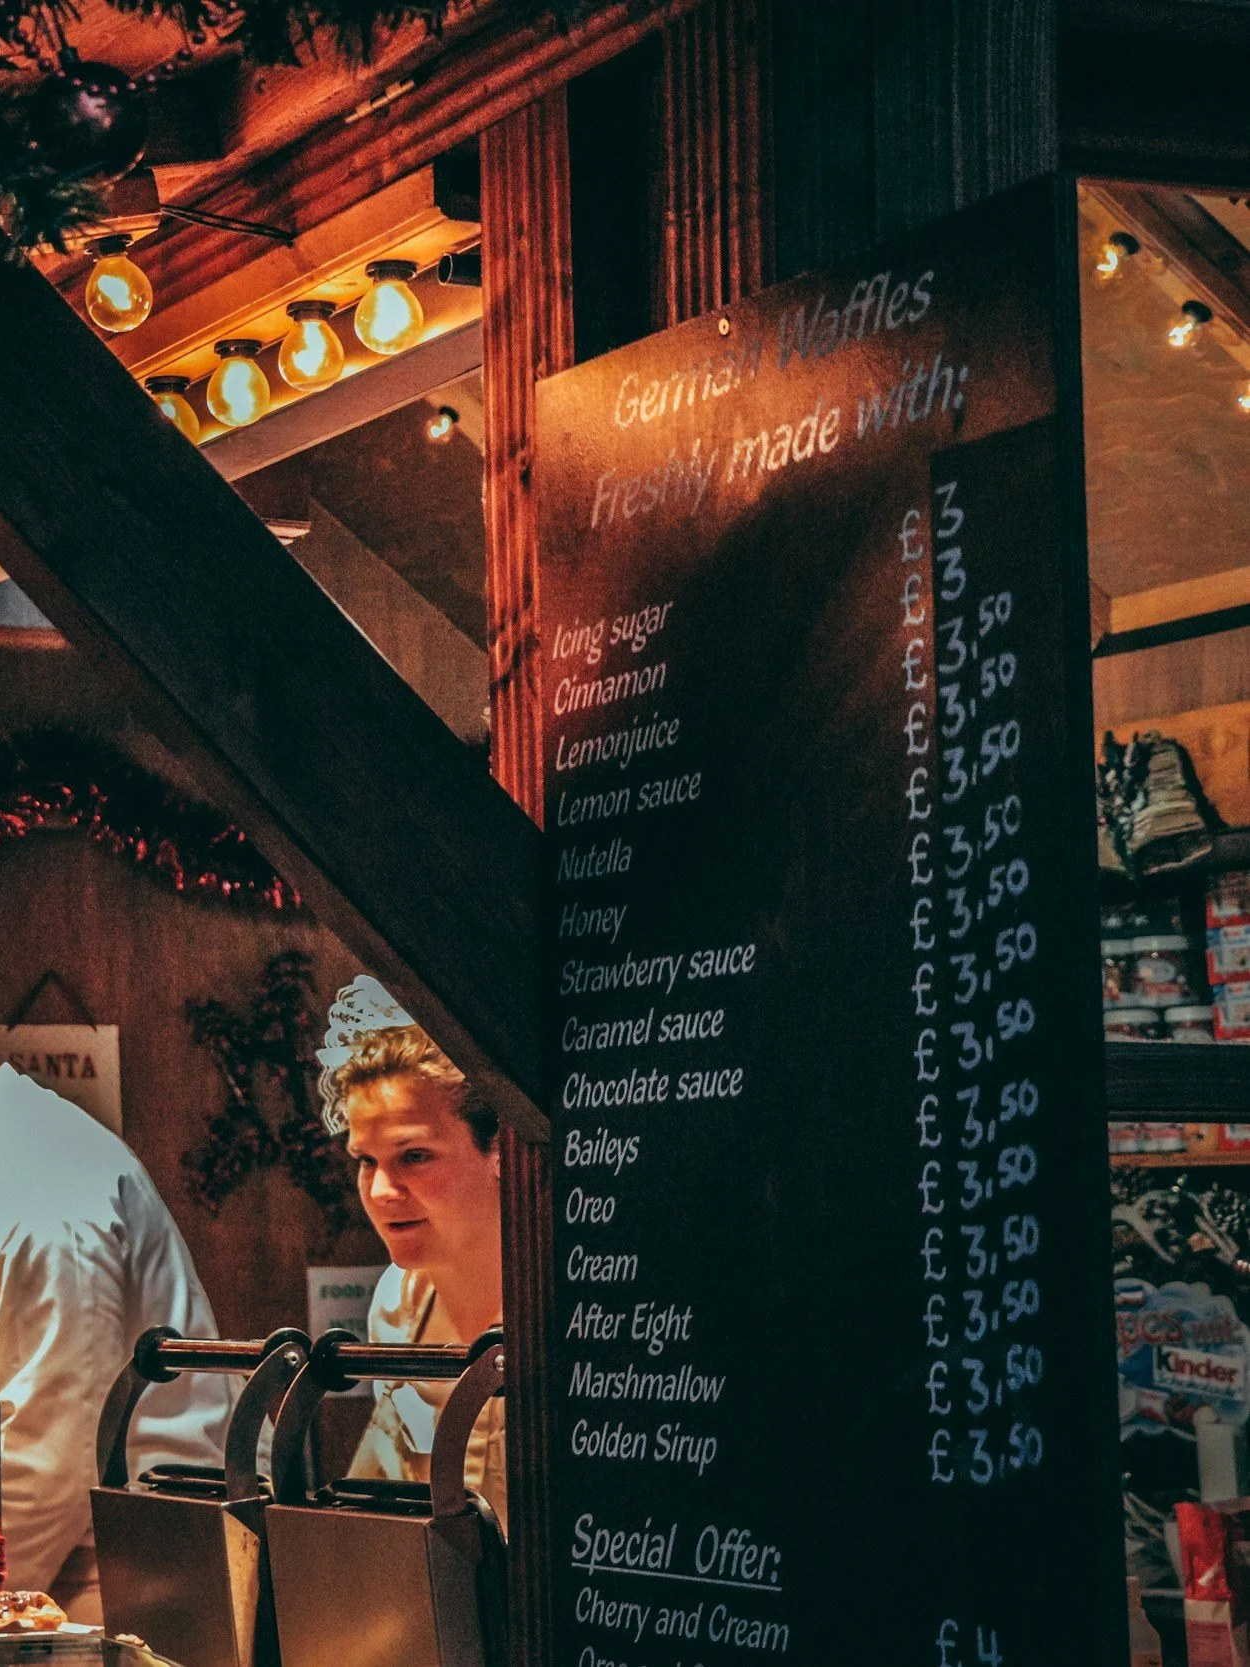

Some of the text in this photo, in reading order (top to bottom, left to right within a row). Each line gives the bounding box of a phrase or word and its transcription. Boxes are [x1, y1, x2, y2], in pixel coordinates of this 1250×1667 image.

[614, 269, 934, 431] German Waffles
[591, 352, 968, 529] Freshly made with:
[935, 481, 964, 538] 3
[937, 546, 966, 600] 3
[551, 598, 674, 665] Icing sugar
[554, 660, 667, 715] Cinnamon
[555, 714, 680, 772] Lemonjuice
[557, 770, 702, 827] Lemon sauce
[557, 838, 633, 882] Nutella
[558, 901, 628, 945] Honey
[559, 943, 756, 997] Strawberry sauce
[562, 1006, 725, 1053] Caramel sauce
[562, 1065, 744, 1110] Chocolate sauce
[564, 1127, 641, 1176] Baileys
[565, 1187, 616, 1225] Oreo
[567, 1245, 639, 1282] Cream
[566, 1301, 693, 1356] After Eight
[568, 1361, 727, 1404] Marshmallow
[571, 1418, 718, 1476] Golden Sirup
[571, 1513, 783, 1584] Special Offer:
[575, 1586, 790, 1652] Cherry and Cream
